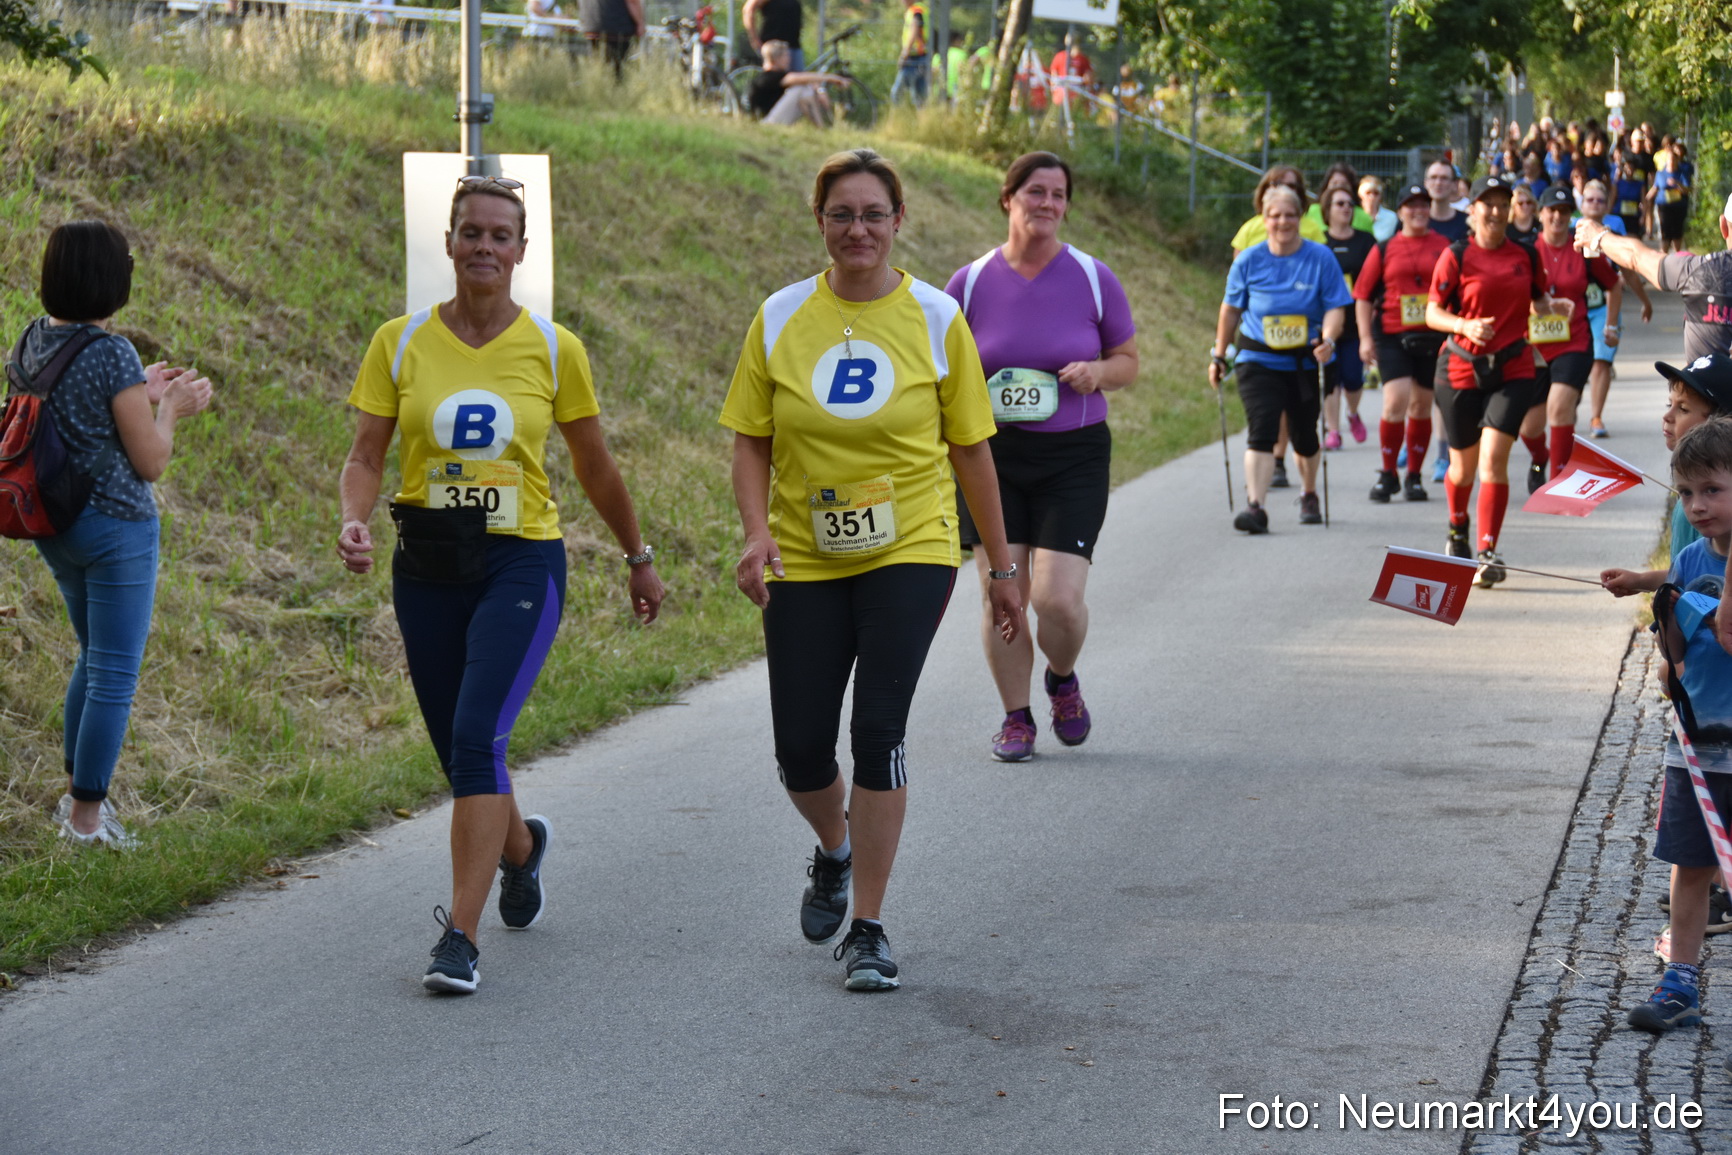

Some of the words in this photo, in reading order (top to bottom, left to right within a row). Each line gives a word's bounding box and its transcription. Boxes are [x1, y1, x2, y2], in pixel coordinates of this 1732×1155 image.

[1270, 326, 1301, 339] 1066
[1534, 321, 1564, 334] 2360
[827, 358, 877, 404] B
[1001, 387, 1041, 407] 629
[451, 404, 496, 449] B
[444, 486, 500, 513] 350
[874, 495, 891, 505] 2019
[824, 506, 876, 538] 351
[823, 536, 868, 546] Lauschmann
[869, 531, 888, 541] Heidi
[864, 541, 881, 549] GmbH
